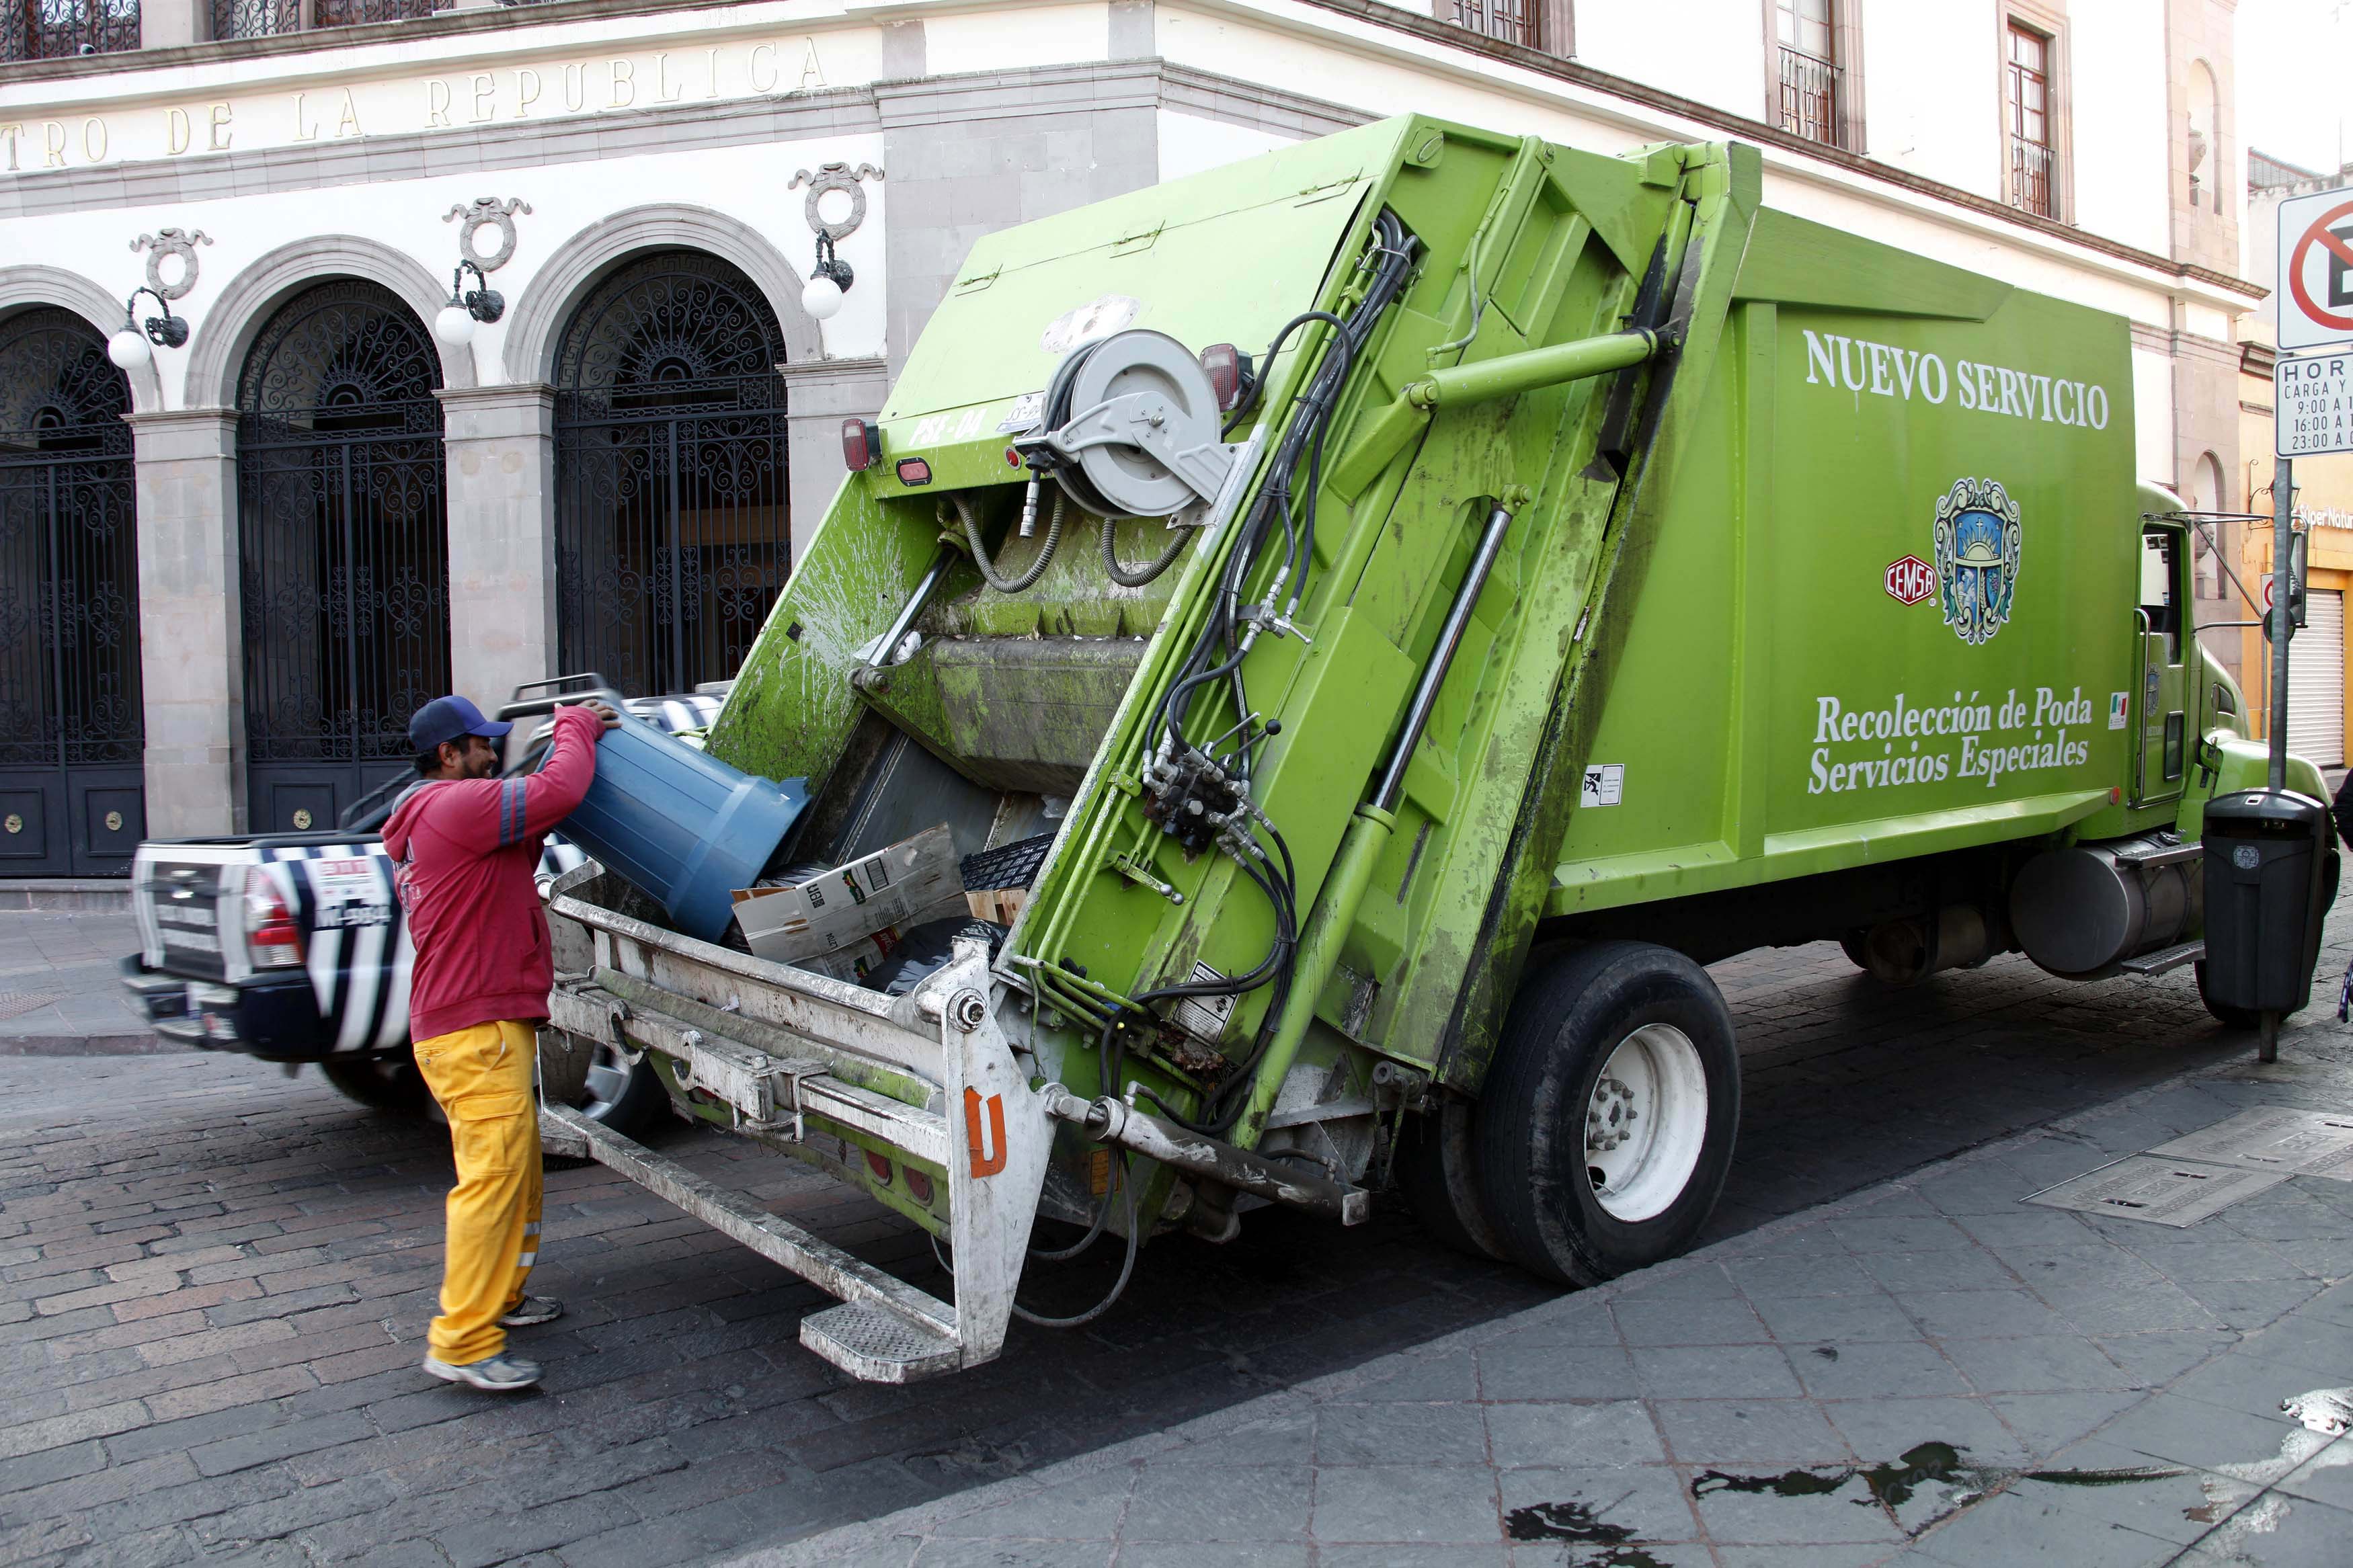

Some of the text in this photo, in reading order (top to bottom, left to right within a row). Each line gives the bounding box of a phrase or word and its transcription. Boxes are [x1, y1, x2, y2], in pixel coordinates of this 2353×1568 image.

[163, 102, 233, 156] DE
[291, 87, 363, 142] LA
[424, 37, 828, 128] REPUBLICA
[1802, 329, 2108, 429] NUEVO SERVICIO
[2284, 379, 2346, 399] CARGA Y
[2295, 416, 2327, 432] 16:00
[2335, 414, 2342, 428] A
[2298, 399, 2326, 415] 9:00
[2334, 397, 2340, 411] A
[2292, 433, 2327, 450] 23:00
[2335, 432, 2342, 446] A
[1886, 563, 1934, 598] CEMSA
[1813, 686, 2093, 743] Recolección de Poda
[1807, 728, 2089, 795] Servicios Especiales
